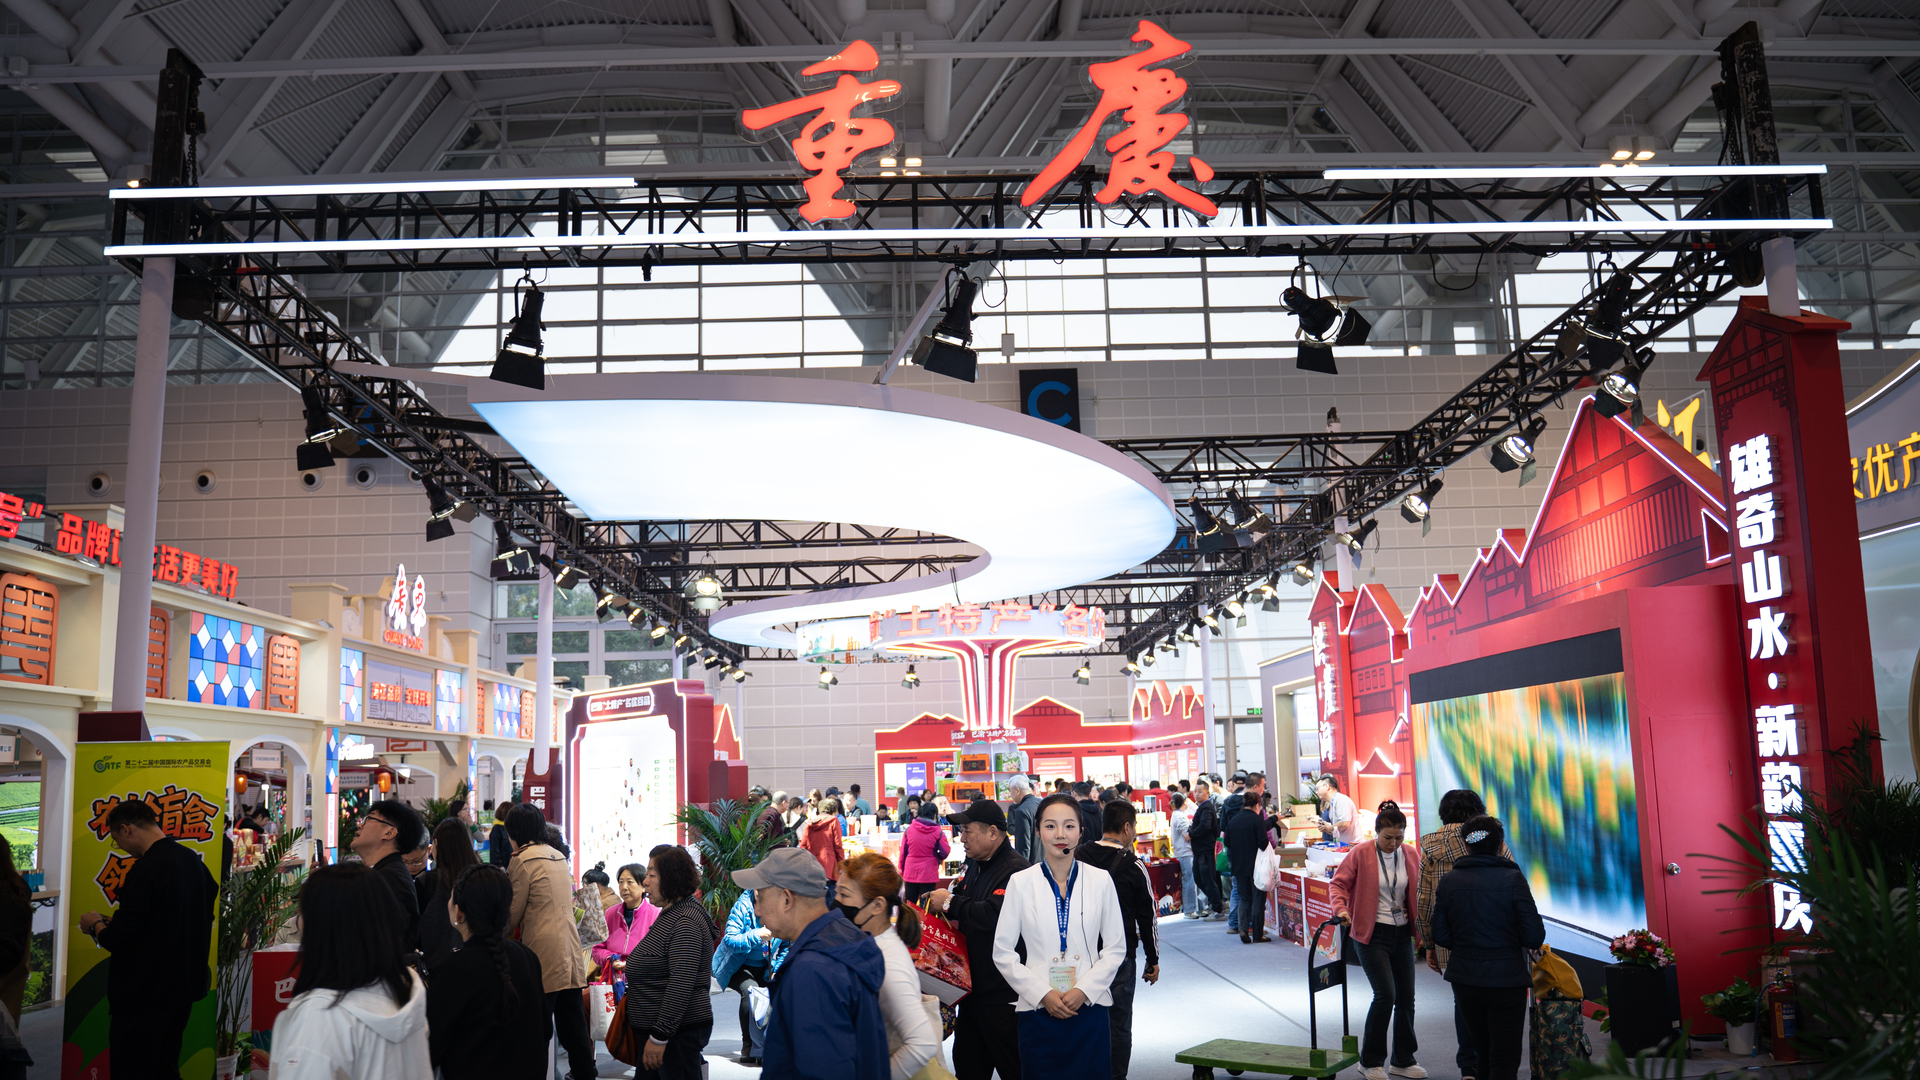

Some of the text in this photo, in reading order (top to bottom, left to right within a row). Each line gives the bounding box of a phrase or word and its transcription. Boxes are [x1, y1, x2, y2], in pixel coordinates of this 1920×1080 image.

[1028, 380, 1072, 426] C
[87, 786, 219, 842] 农盲盒
